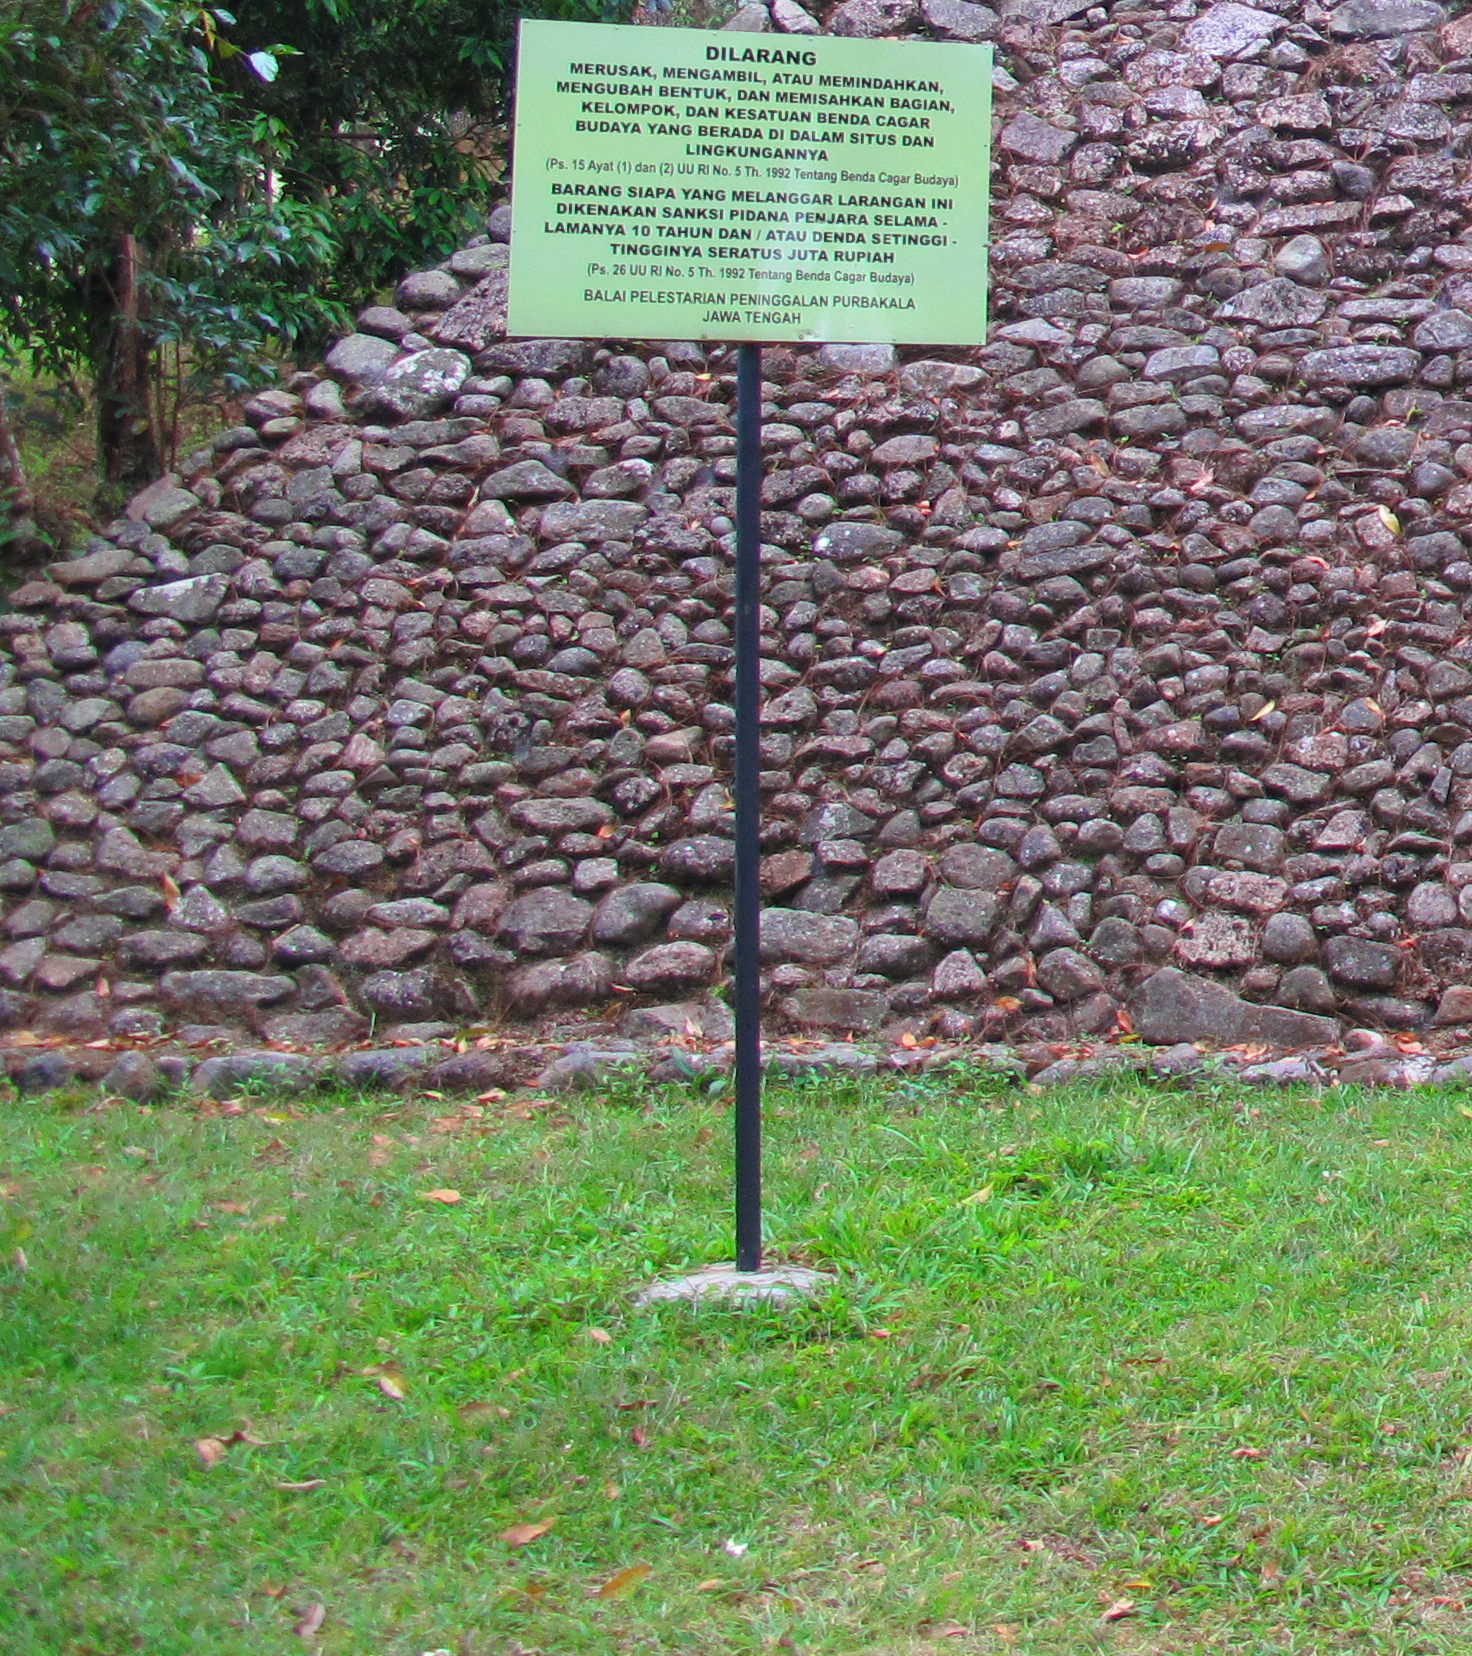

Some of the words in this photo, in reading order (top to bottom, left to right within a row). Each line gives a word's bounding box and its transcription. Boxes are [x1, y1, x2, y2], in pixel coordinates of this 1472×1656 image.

[705, 45, 817, 67] DILARANG
[569, 62, 658, 81] MERUSAK,
[662, 66, 768, 87] MENGAMBIL,
[771, 72, 814, 87] ATAU
[818, 74, 945, 96] MEMINDAHKAN,
[556, 80, 654, 97] MENGUBAH
[658, 85, 733, 104] BENTUK,
[736, 88, 771, 103] DAN
[774, 90, 886, 109] MEMISAHKAN
[889, 96, 956, 115] BAGIAN,
[581, 100, 681, 121] KELOMPOK,
[685, 104, 720, 119] DAN
[724, 107, 812, 124] KESATUAN
[816, 111, 872, 127] BENDA
[875, 114, 931, 130] CAGAR
[575, 119, 643, 135] BUDAYA
[646, 122, 693, 137] YANG
[697, 124, 765, 140] BERADA
[767, 127, 785, 141] DI
[789, 128, 845, 144] DALAM
[849, 132, 898, 147] SITUS
[901, 134, 935, 148] DAN
[685, 143, 829, 162] LINGKUNGANNYA
[545, 157, 569, 172] (Ps.
[571, 158, 586, 172] 15
[586, 159, 615, 175] Ayat
[616, 160, 633, 176] (1)
[634, 160, 657, 174] dan
[658, 161, 675, 178] (2)
[676, 162, 695, 176] UU
[712, 163, 733, 177] No.
[733, 164, 742, 178] 5
[743, 164, 763, 178] Th.
[765, 165, 792, 180] 1992
[793, 166, 838, 185] Tentang
[839, 169, 876, 183] Benda
[877, 171, 912, 187] Cagar
[913, 172, 959, 189] Budaya)
[550, 182, 623, 198] BARANG
[626, 185, 677, 200] SIAPA
[680, 187, 727, 202] YANG
[731, 189, 834, 207] MELANGGAR
[837, 193, 927, 210] LARANGAN
[931, 197, 954, 211] INI
[556, 201, 657, 219] DIKENAKAN
[661, 206, 725, 221] SANKSI
[729, 208, 791, 224] PIDANA
[794, 211, 871, 227] PENJARA
[872, 214, 939, 229] SELAMA
[543, 221, 627, 237] LAMANYA
[631, 224, 651, 238] 10
[655, 224, 714, 240] TAHUN
[718, 227, 753, 241] DAN
[764, 229, 808, 243] ATAU
[811, 230, 868, 245] DENDA
[870, 232, 948, 247] SETINGGI
[609, 242, 704, 259] TINGGINYA
[707, 245, 783, 261] SERATUS
[786, 248, 830, 263] JUTA
[833, 249, 895, 264] RUPIAH
[587, 262, 610, 278] (Ps.
[612, 263, 629, 278] 26
[629, 263, 648, 277] UU
[664, 264, 685, 280] No.
[687, 265, 696, 279] 5
[696, 264, 717, 279] Th.
[718, 266, 746, 280] 1992
[747, 266, 793, 284] Tentang
[793, 268, 832, 282] Benda
[833, 268, 868, 285] Cagar
[868, 270, 915, 287] Budaya)
[583, 288, 627, 303] BALAI
[630, 289, 727, 306] PELESTARIAN
[729, 292, 829, 308] PENINGGALAN
[832, 295, 916, 310] PURBAKALA
[701, 309, 742, 324] JAWA
[743, 310, 802, 325] TENGAH
